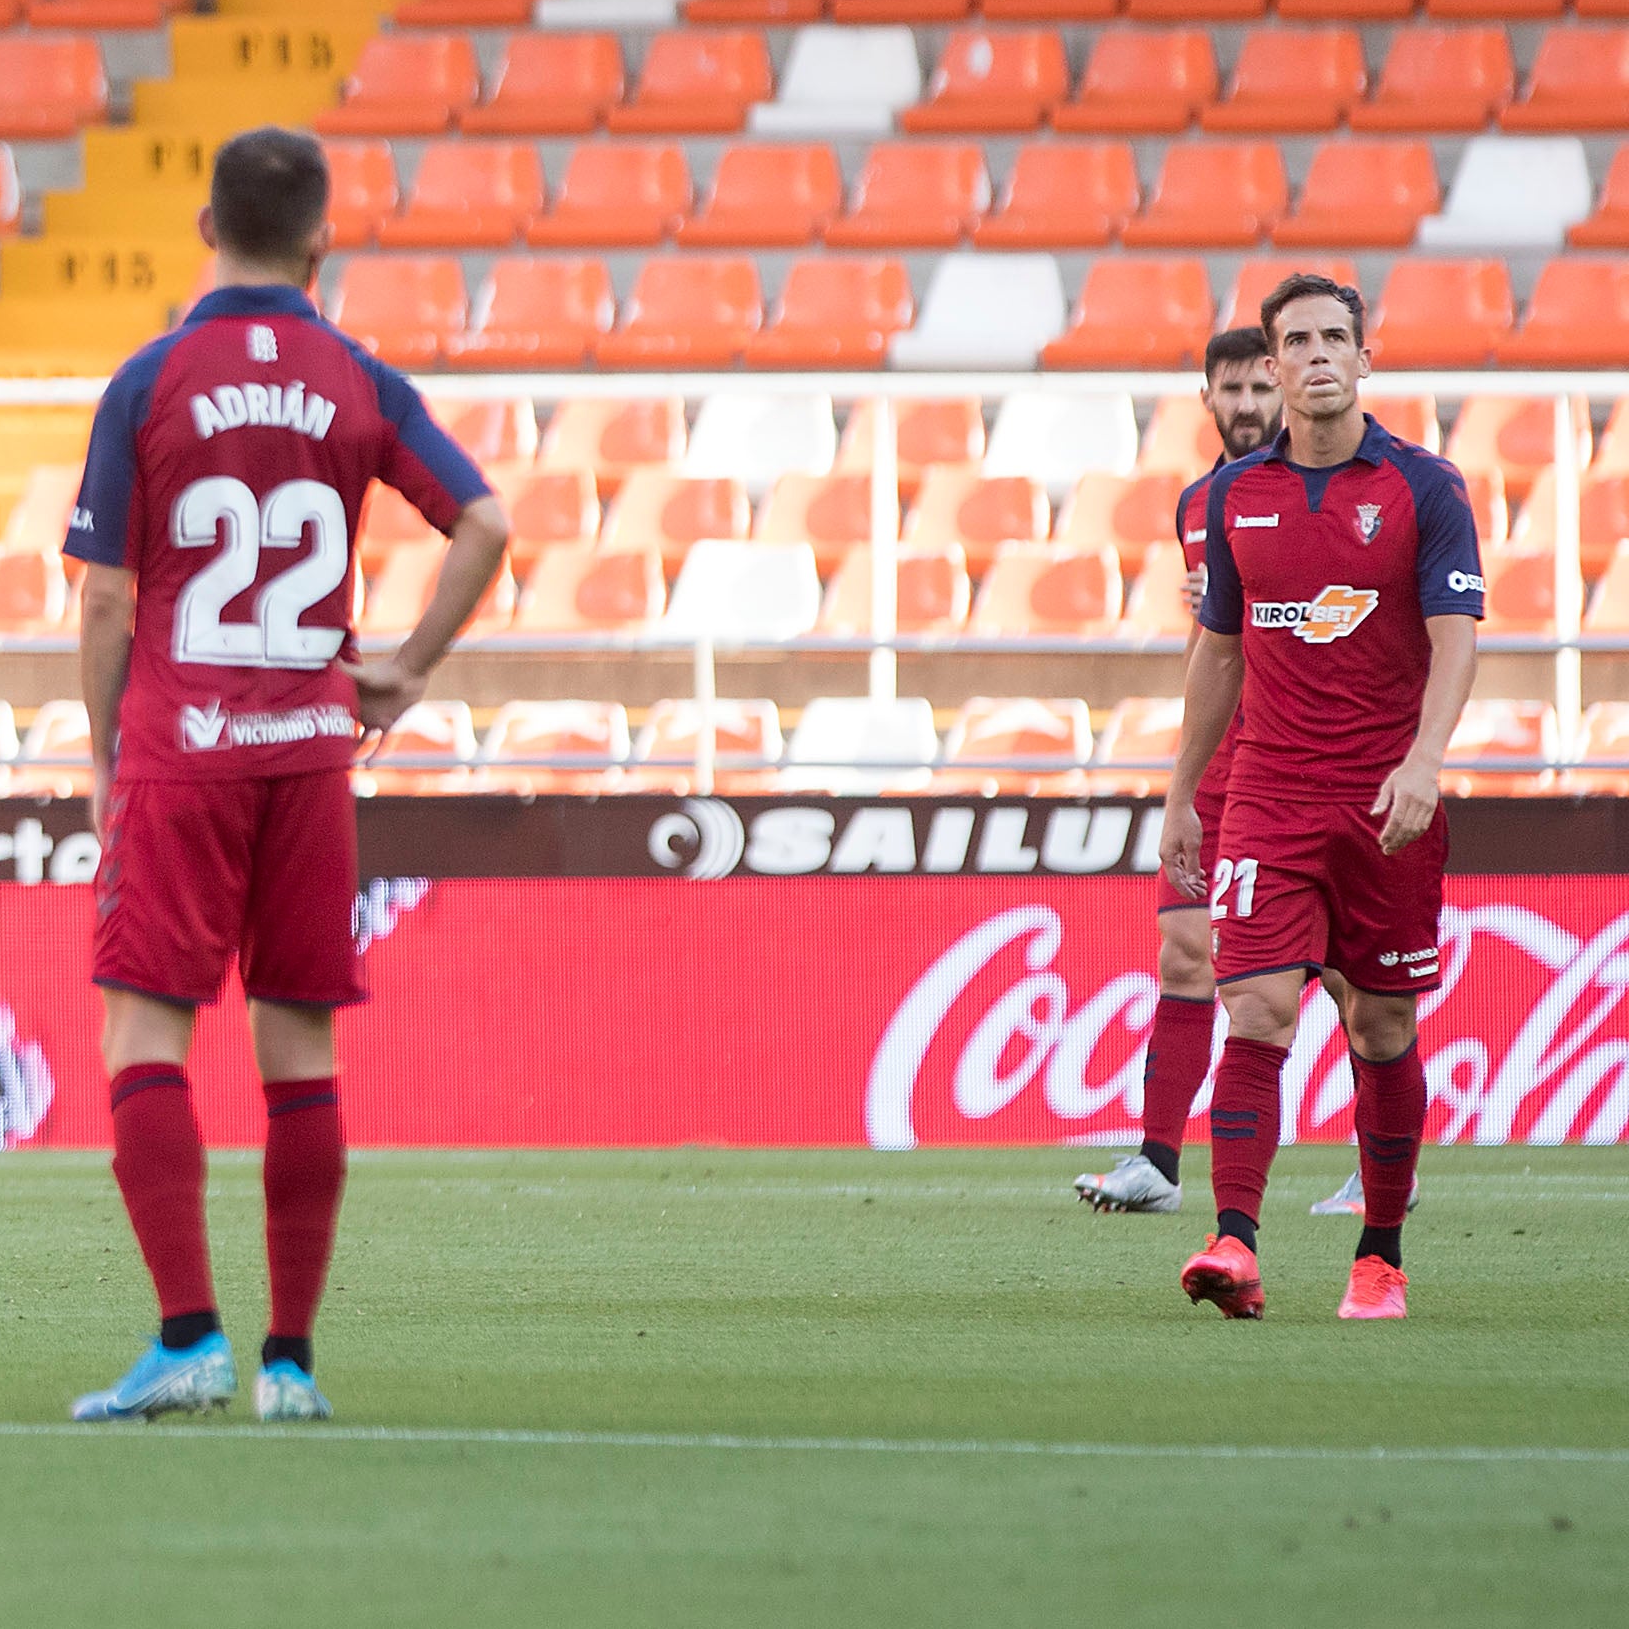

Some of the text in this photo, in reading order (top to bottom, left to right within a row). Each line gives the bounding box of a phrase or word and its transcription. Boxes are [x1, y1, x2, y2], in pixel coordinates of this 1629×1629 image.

[192, 379, 338, 442] ADRIÁN
[171, 475, 348, 670] 22
[231, 717, 316, 747] VICTORINO
[1210, 857, 1259, 921] 21
